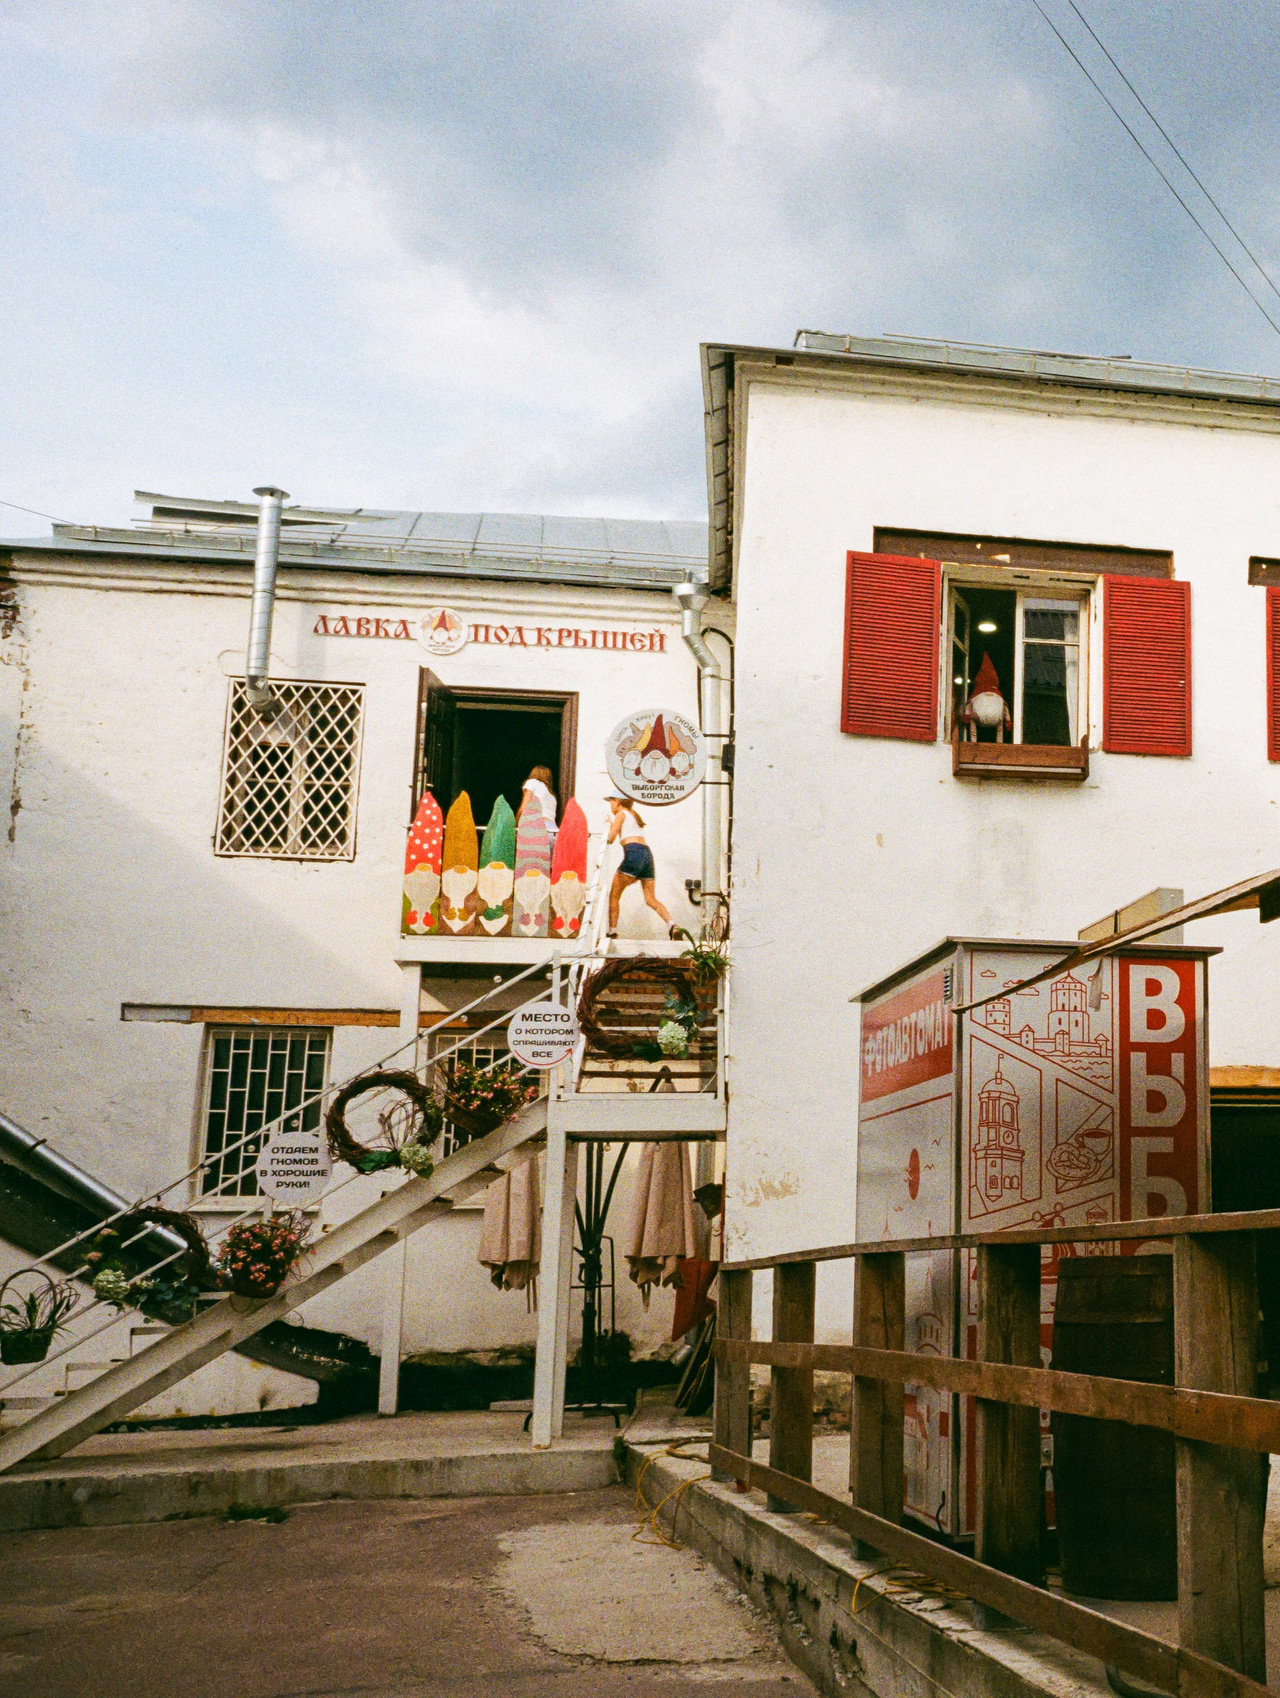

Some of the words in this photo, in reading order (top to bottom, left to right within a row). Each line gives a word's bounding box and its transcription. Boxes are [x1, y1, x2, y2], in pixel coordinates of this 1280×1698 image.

[313, 614, 411, 639] ЛАВКА
[472, 624, 528, 648] ПОД
[536, 628, 667, 652] КРЫШЕЙ
[674, 715, 699, 740] ГНОМЫ
[631, 784, 685, 792] ВЫБОРГСКАЯ
[641, 792, 676, 800] БОРОДА
[521, 1013, 571, 1023] МЕСТО
[525, 1028, 574, 1036] КОТОРОМ
[1129, 964, 1189, 1256] ВЫБ
[271, 1146, 319, 1154] ОТДАЕМ
[270, 1158, 319, 1166] ГНОМОВ
[260, 1169, 268, 1177] В
[271, 1169, 328, 1177] ХОРОШИЕ
